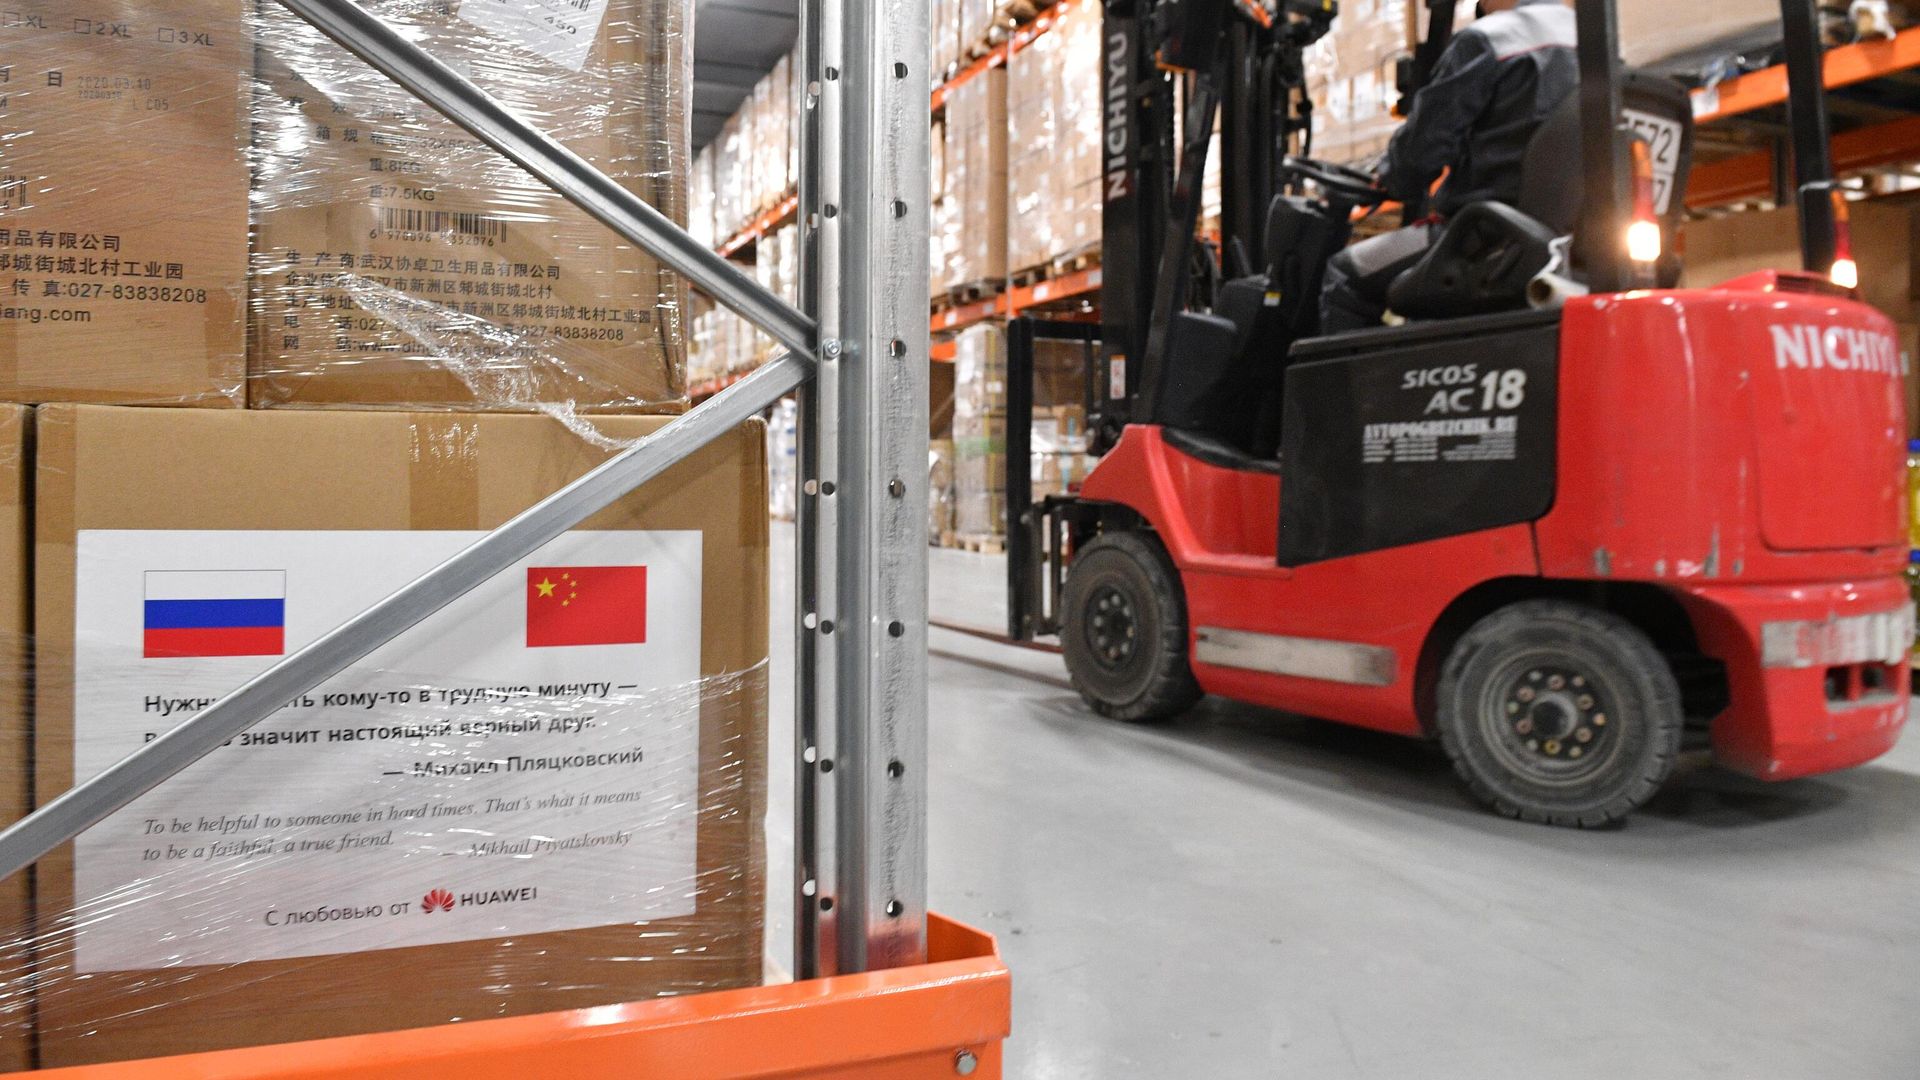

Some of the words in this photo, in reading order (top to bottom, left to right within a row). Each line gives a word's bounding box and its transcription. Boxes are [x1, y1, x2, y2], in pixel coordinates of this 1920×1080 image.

[1108, 32, 1127, 201] NICHIYU
[1401, 363, 1478, 389] SICOS
[1423, 387, 1475, 415] AC
[1480, 369, 1527, 411] 18
[145, 696, 216, 716] Нужн
[323, 690, 410, 709] кому-то
[420, 689, 431, 702] в
[538, 682, 611, 699] минуту
[240, 731, 321, 746] значит
[328, 720, 451, 743] настоящий
[506, 746, 643, 773] Пляцковский
[144, 818, 165, 834] To
[171, 816, 192, 832] be
[199, 813, 259, 835] helpful
[266, 814, 281, 829] to
[287, 810, 361, 828] someone
[366, 806, 383, 822] in
[388, 802, 428, 821] hard
[432, 801, 478, 817] times.
[486, 797, 532, 815] That's
[537, 794, 574, 809] what
[579, 793, 590, 807] it
[594, 790, 642, 805] means
[143, 848, 161, 861] to
[167, 843, 188, 860] be
[193, 846, 205, 858] a
[284, 840, 296, 854] a
[300, 838, 336, 853] true
[338, 831, 395, 852] friend.
[468, 838, 531, 858] Mikhail
[460, 887, 538, 907] HUAWEI
[266, 910, 279, 926] С
[284, 905, 383, 925] любовью
[390, 902, 411, 917] от
